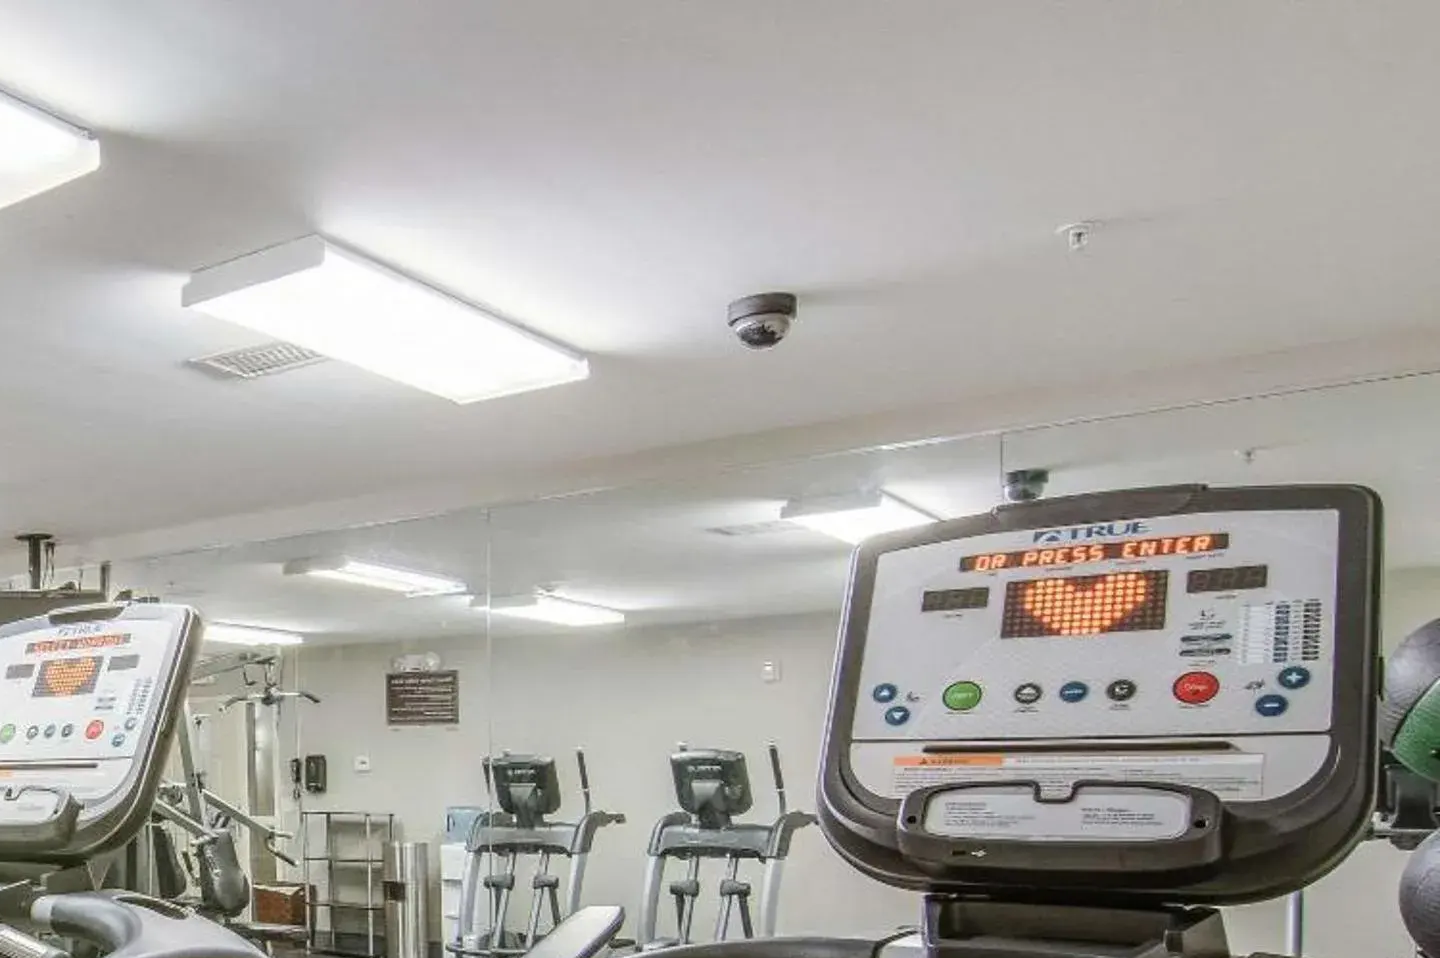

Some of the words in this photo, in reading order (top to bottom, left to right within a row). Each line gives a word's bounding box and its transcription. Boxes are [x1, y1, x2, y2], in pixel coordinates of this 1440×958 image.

[1068, 521, 1150, 540] TRUE
[1021, 544, 1105, 566] PRESS
[1122, 534, 1212, 557] ENTER
